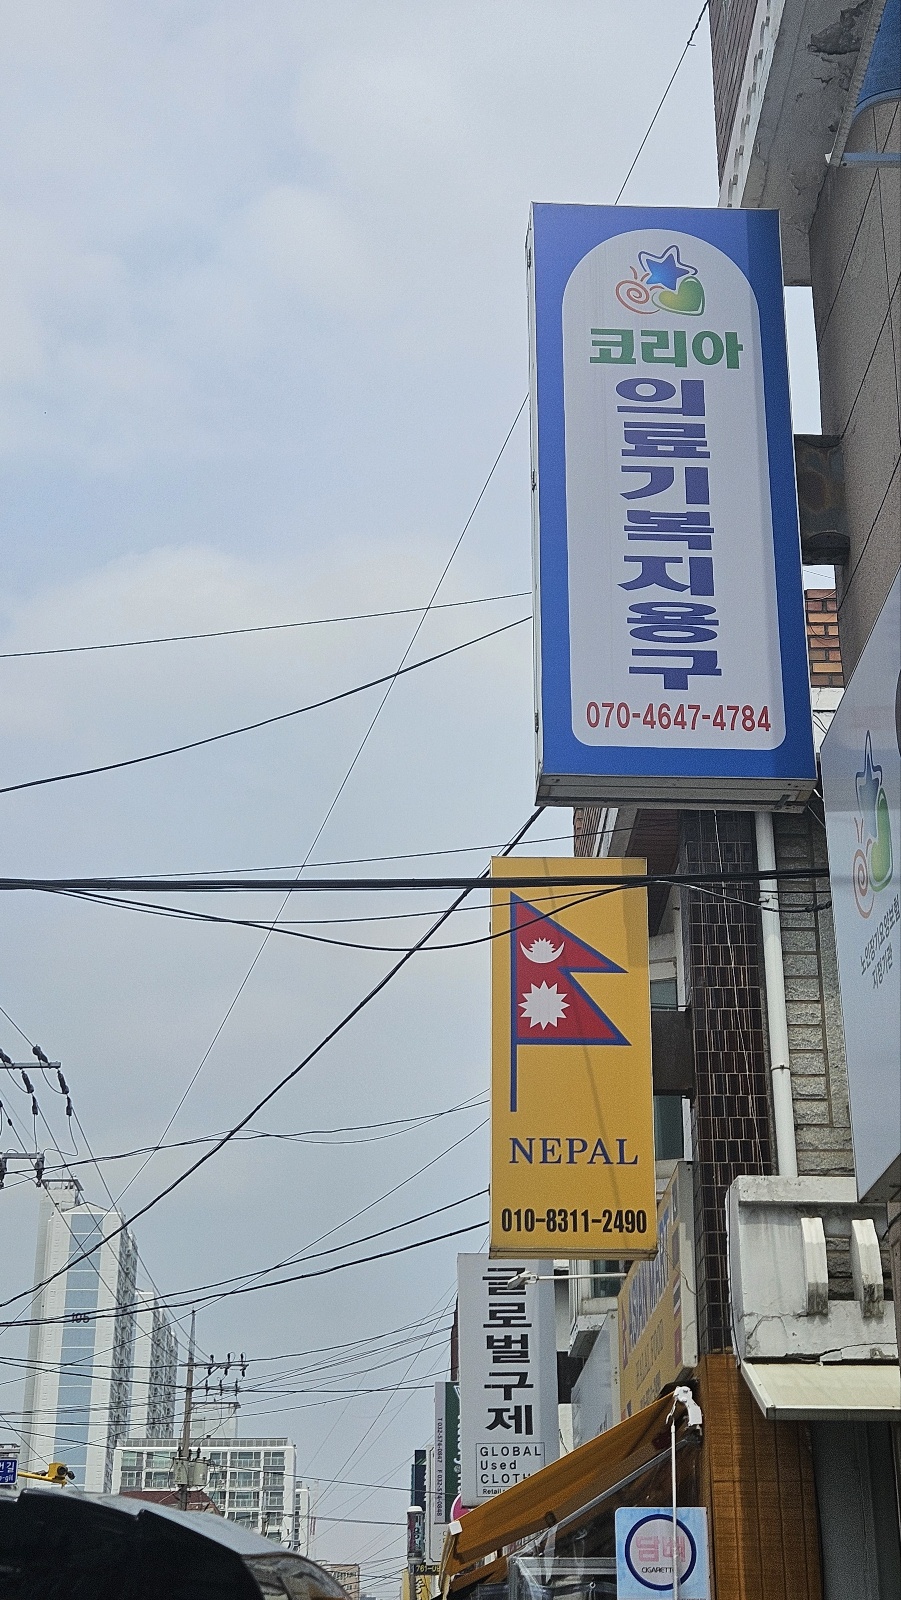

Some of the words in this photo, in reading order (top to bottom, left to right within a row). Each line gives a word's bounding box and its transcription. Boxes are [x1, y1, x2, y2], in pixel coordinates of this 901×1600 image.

[590, 328, 744, 369] 코리아
[586, 701, 771, 732] 070-4647-4784
[860, 893, 901, 976] 노인장기요양보험
[872, 942, 893, 990] 지정기관
[509, 1137, 639, 1165] NEPAL
[501, 1208, 647, 1234] 010-8311-2490
[480, 1446, 542, 1457] GLOBAL
[480, 1460, 517, 1470] Used
[636, 1536, 686, 1562] 담배
